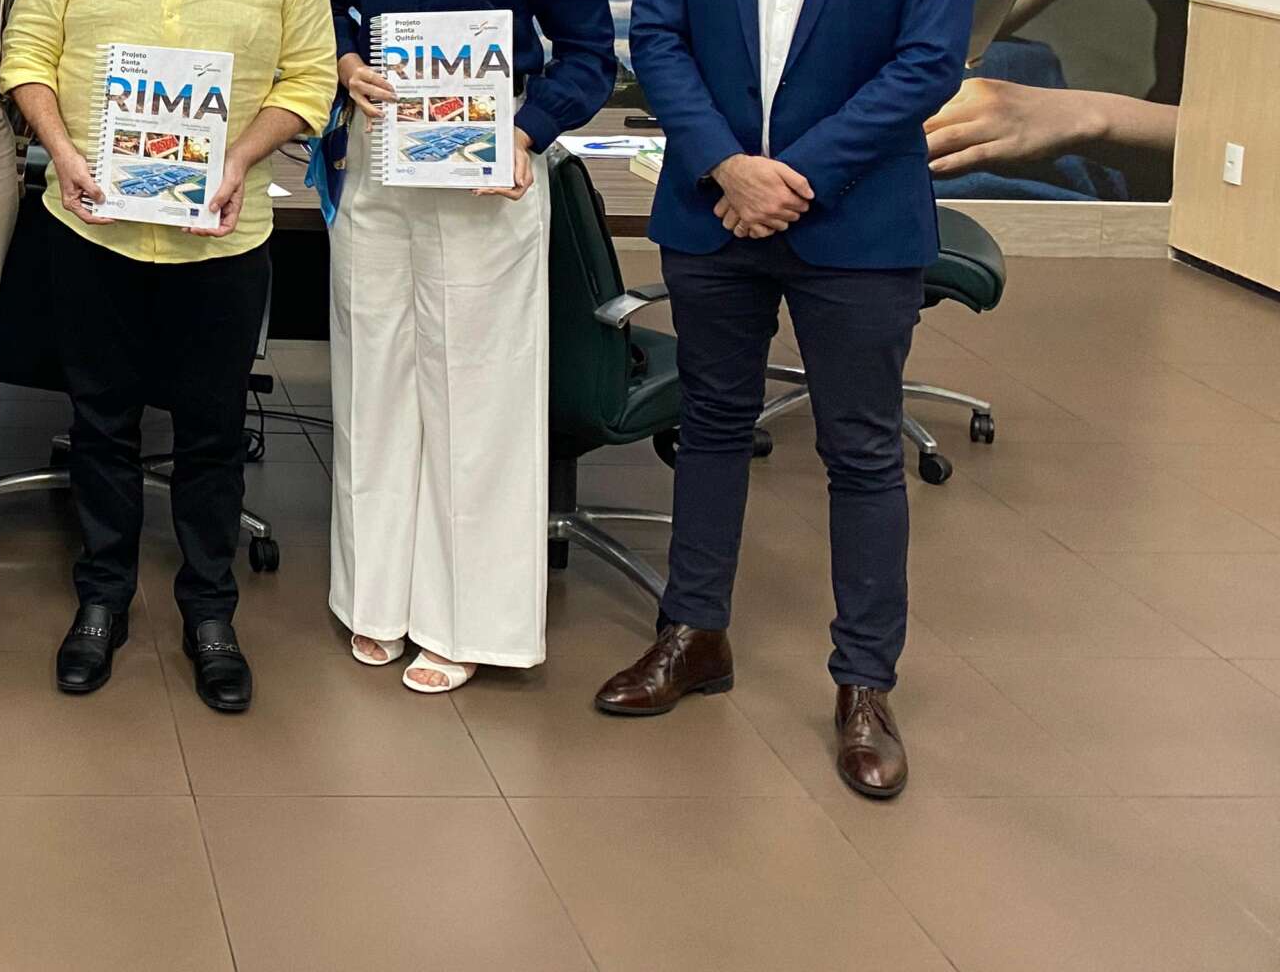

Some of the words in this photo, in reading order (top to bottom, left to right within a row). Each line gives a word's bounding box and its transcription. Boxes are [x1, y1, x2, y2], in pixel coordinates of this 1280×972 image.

[120, 58, 141, 66] Santa
[121, 50, 147, 59] Projeto
[382, 44, 511, 80] RIMA
[106, 75, 228, 122] RIMA
